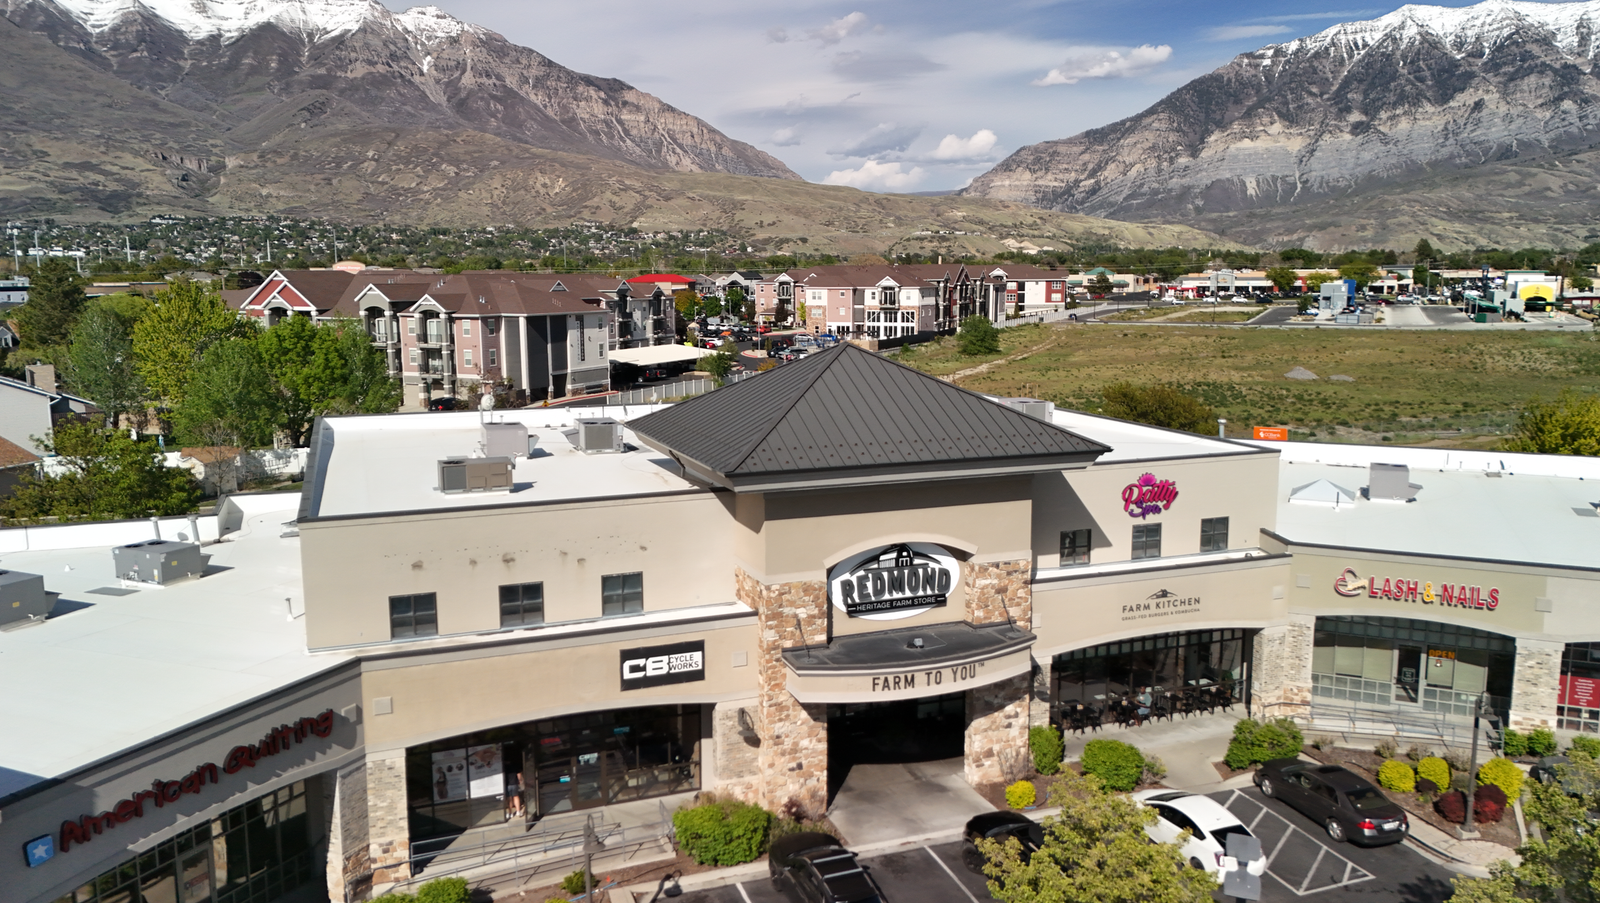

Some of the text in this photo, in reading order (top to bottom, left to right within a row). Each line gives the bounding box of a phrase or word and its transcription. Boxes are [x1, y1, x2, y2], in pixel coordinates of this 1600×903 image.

[1122, 479, 1179, 512] Patty
[1128, 500, 1162, 520] Spa
[840, 566, 951, 604] REDMOND
[1368, 575, 1500, 609] LASH & NAILS
[856, 596, 936, 611] HERITAGE FARM STORE
[1122, 597, 1201, 613] FARM KITCHEN
[669, 654, 694, 664] CYCLE
[1428, 649, 1455, 660] OPEN
[669, 661, 700, 671] WORKS
[872, 673, 915, 692] FARM
[925, 670, 942, 687] TO
[59, 708, 334, 853] American Quilting
